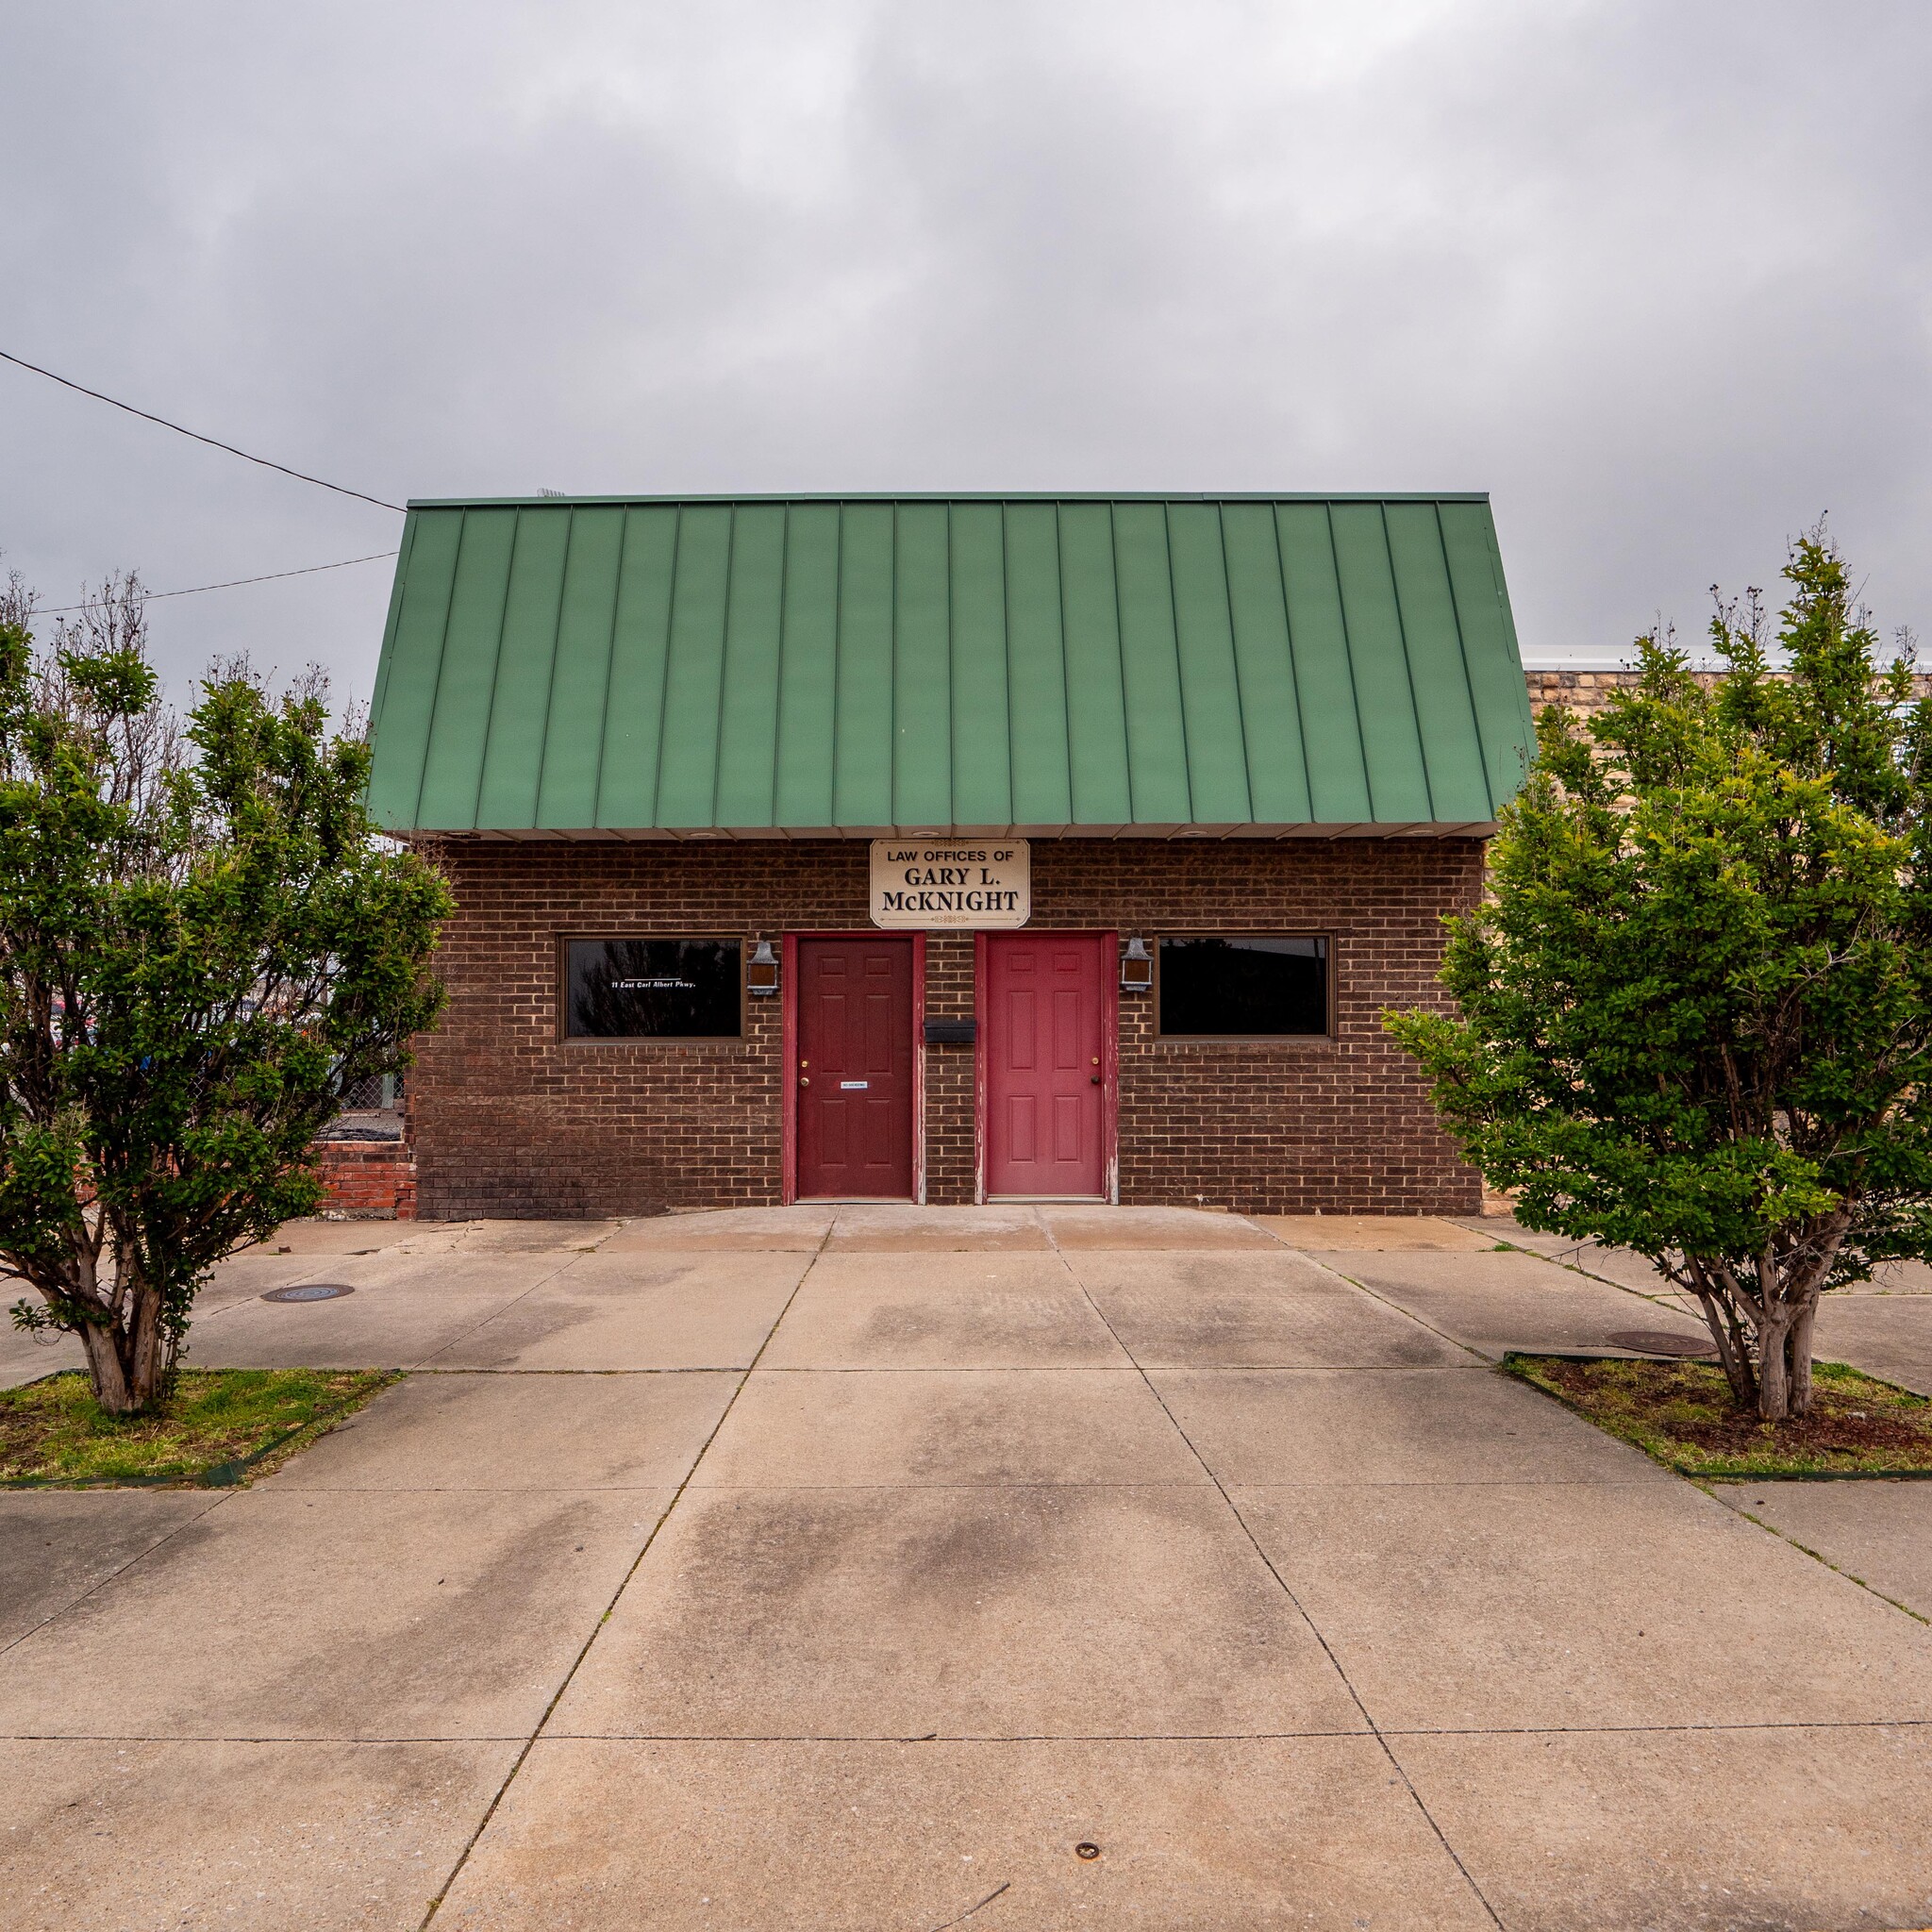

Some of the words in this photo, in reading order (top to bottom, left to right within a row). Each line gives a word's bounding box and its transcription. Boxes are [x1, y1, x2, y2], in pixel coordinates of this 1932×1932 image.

[888, 851, 918, 861] LAW
[924, 851, 986, 861] OFFICES
[993, 851, 1014, 861] OF
[905, 868, 970, 886] GARY
[980, 868, 1000, 885] L.
[882, 891, 1019, 911] McKNIGHT
